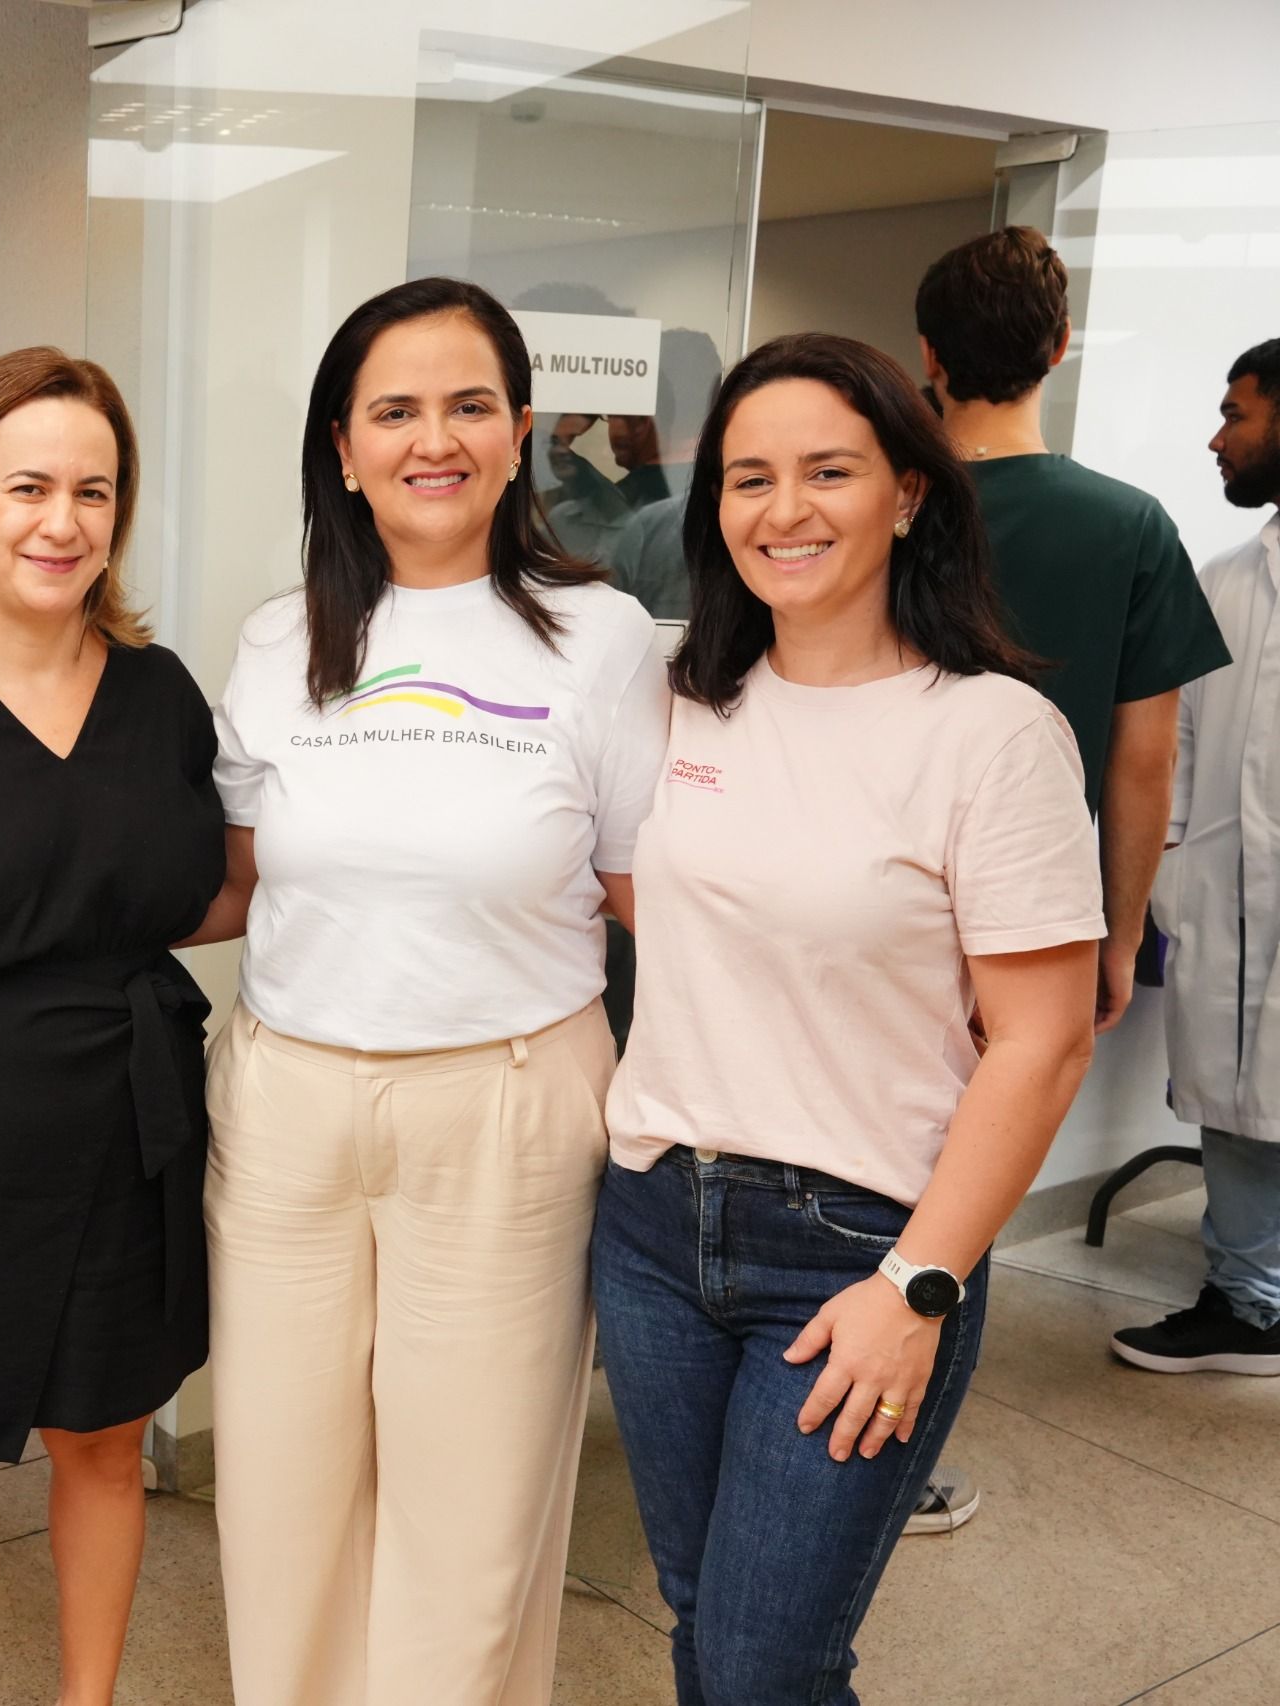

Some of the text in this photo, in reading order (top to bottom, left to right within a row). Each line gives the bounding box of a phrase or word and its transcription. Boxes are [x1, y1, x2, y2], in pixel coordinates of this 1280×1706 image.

[550, 354, 648, 377] MULTIUSO
[290, 728, 547, 755] CASA DA MULHER BRASILEIRA
[671, 768, 717, 784] PARTIDA
[675, 759, 716, 774] PONTO
